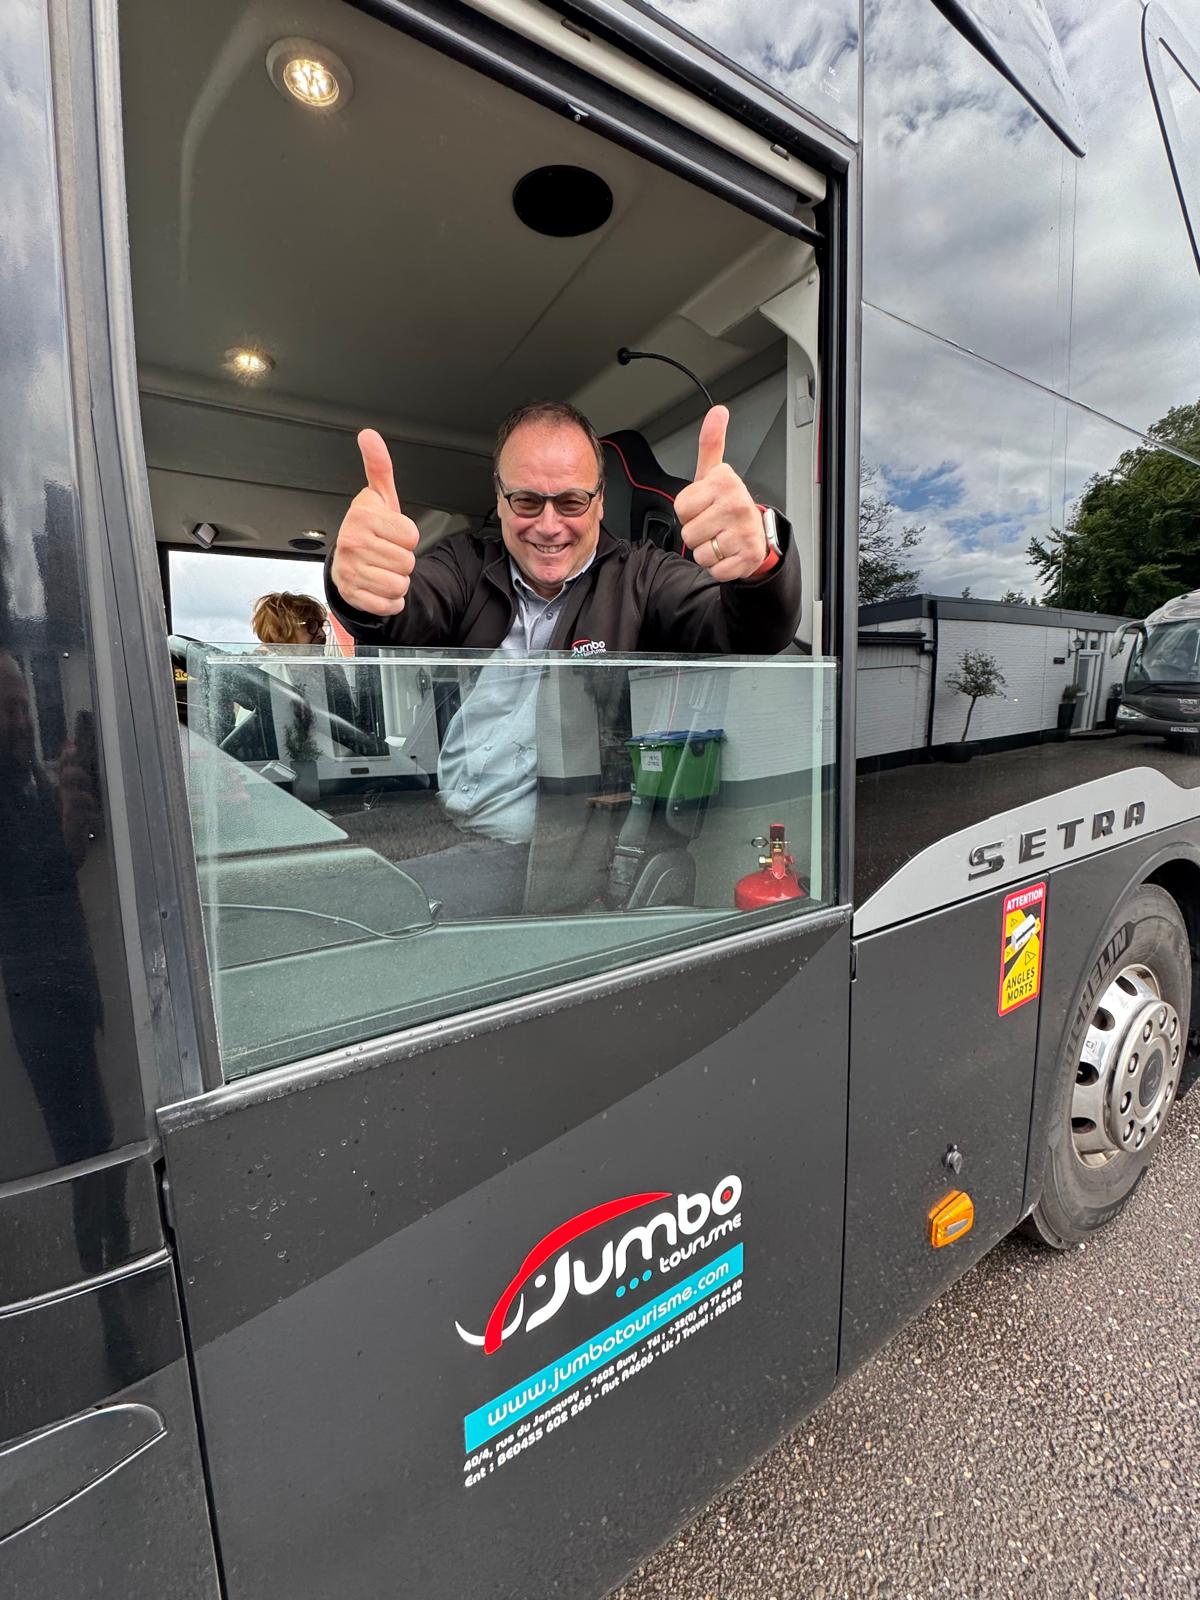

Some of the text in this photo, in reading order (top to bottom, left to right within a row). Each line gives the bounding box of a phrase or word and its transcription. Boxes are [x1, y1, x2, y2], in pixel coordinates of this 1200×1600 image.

[968, 801, 1145, 881] SETRA
[1006, 887, 1043, 912] ATTENTION
[1006, 966, 1035, 990] ANGLES
[1006, 980, 1033, 1003] MORTS
[659, 1213, 742, 1273] tourisme
[463, 1448, 493, 1472] 40/4,
[495, 1434, 515, 1452] rue
[516, 1422, 531, 1437] du
[591, 1365, 615, 1388] 7602
[616, 1351, 638, 1371] Bury
[668, 1310, 697, 1335] +32(0)
[698, 1301, 709, 1316] 69
[710, 1293, 720, 1307] 77
[732, 1278, 743, 1292] 60
[487, 1261, 729, 1427] www.jumbotourisme.com
[464, 1467, 486, 1488] Ent
[497, 1427, 543, 1467] BE0455
[545, 1410, 569, 1433] 602
[570, 1394, 593, 1417] 268
[601, 1376, 620, 1396] Aut
[621, 1351, 654, 1382] A4606
[682, 1313, 709, 1339] Travel
